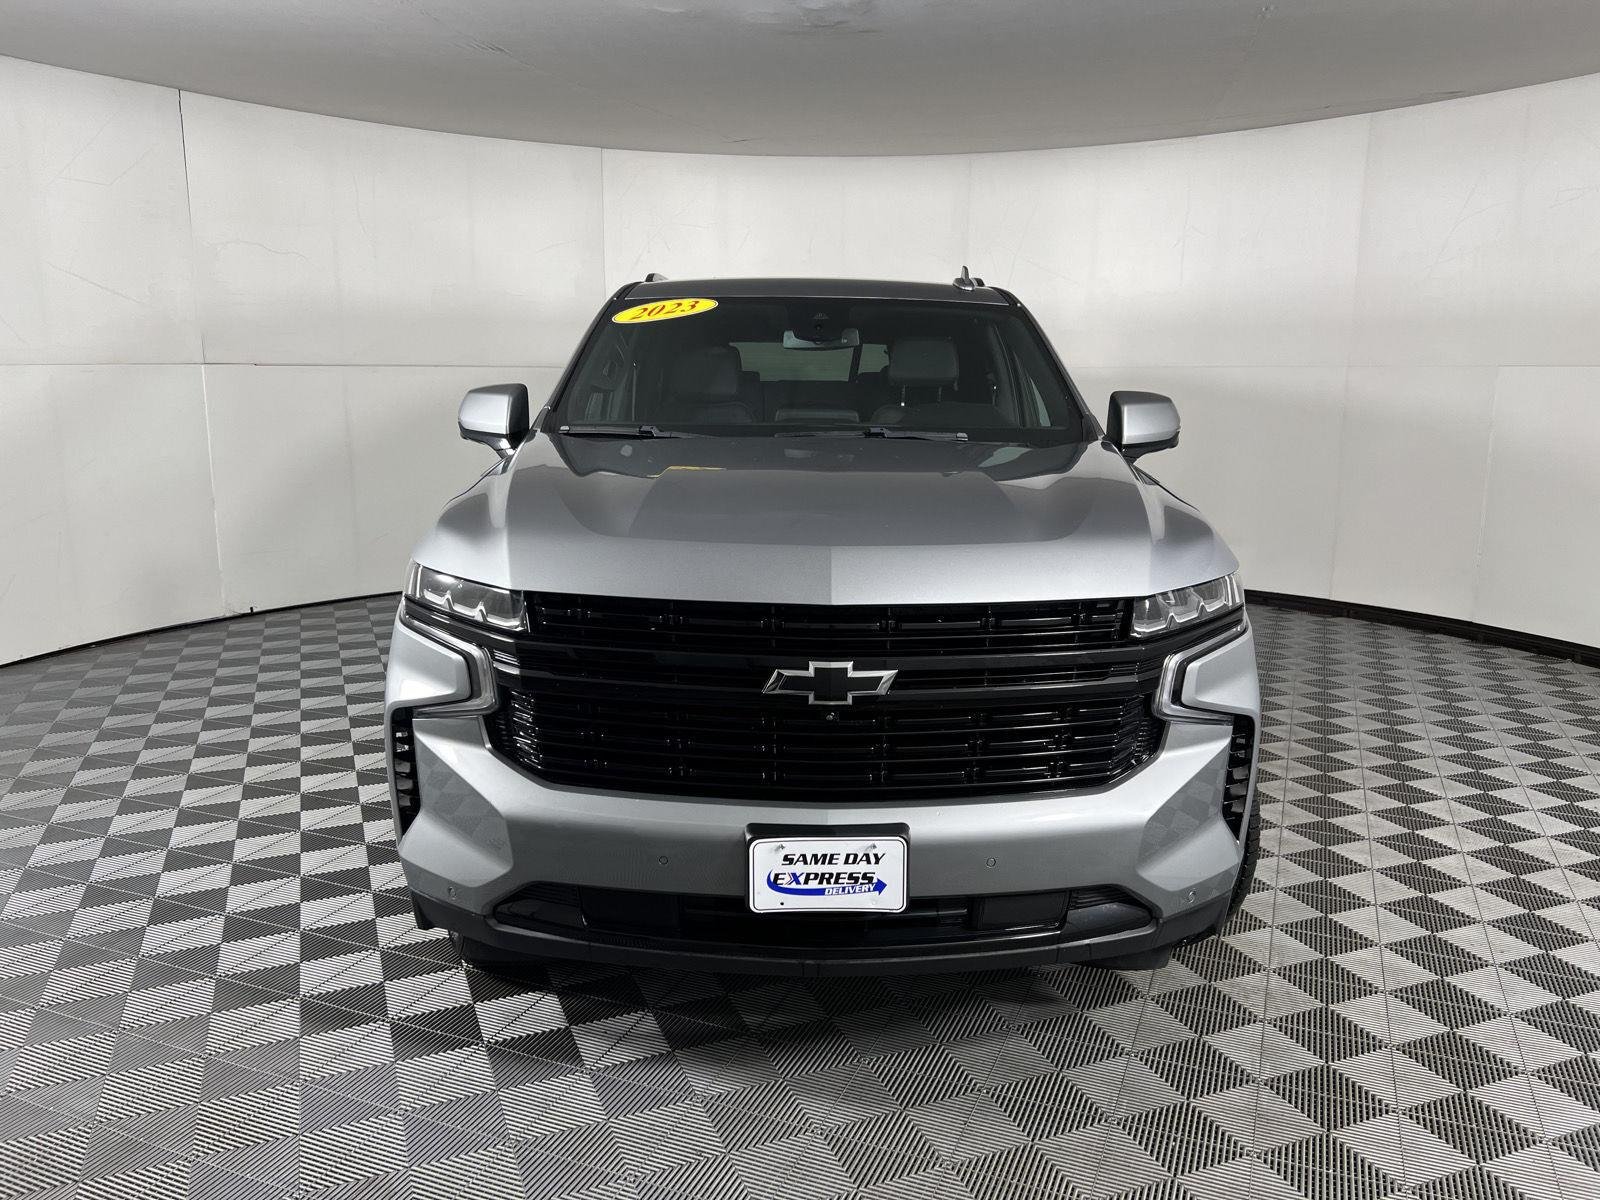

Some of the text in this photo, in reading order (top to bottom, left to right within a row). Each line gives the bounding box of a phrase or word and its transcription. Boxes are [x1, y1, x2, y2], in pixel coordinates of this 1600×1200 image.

[629, 300, 700, 321] 2023
[781, 852, 886, 866] SAME DAY
[772, 871, 876, 886] EXPRESS
[824, 883, 876, 896] DELIVERY
